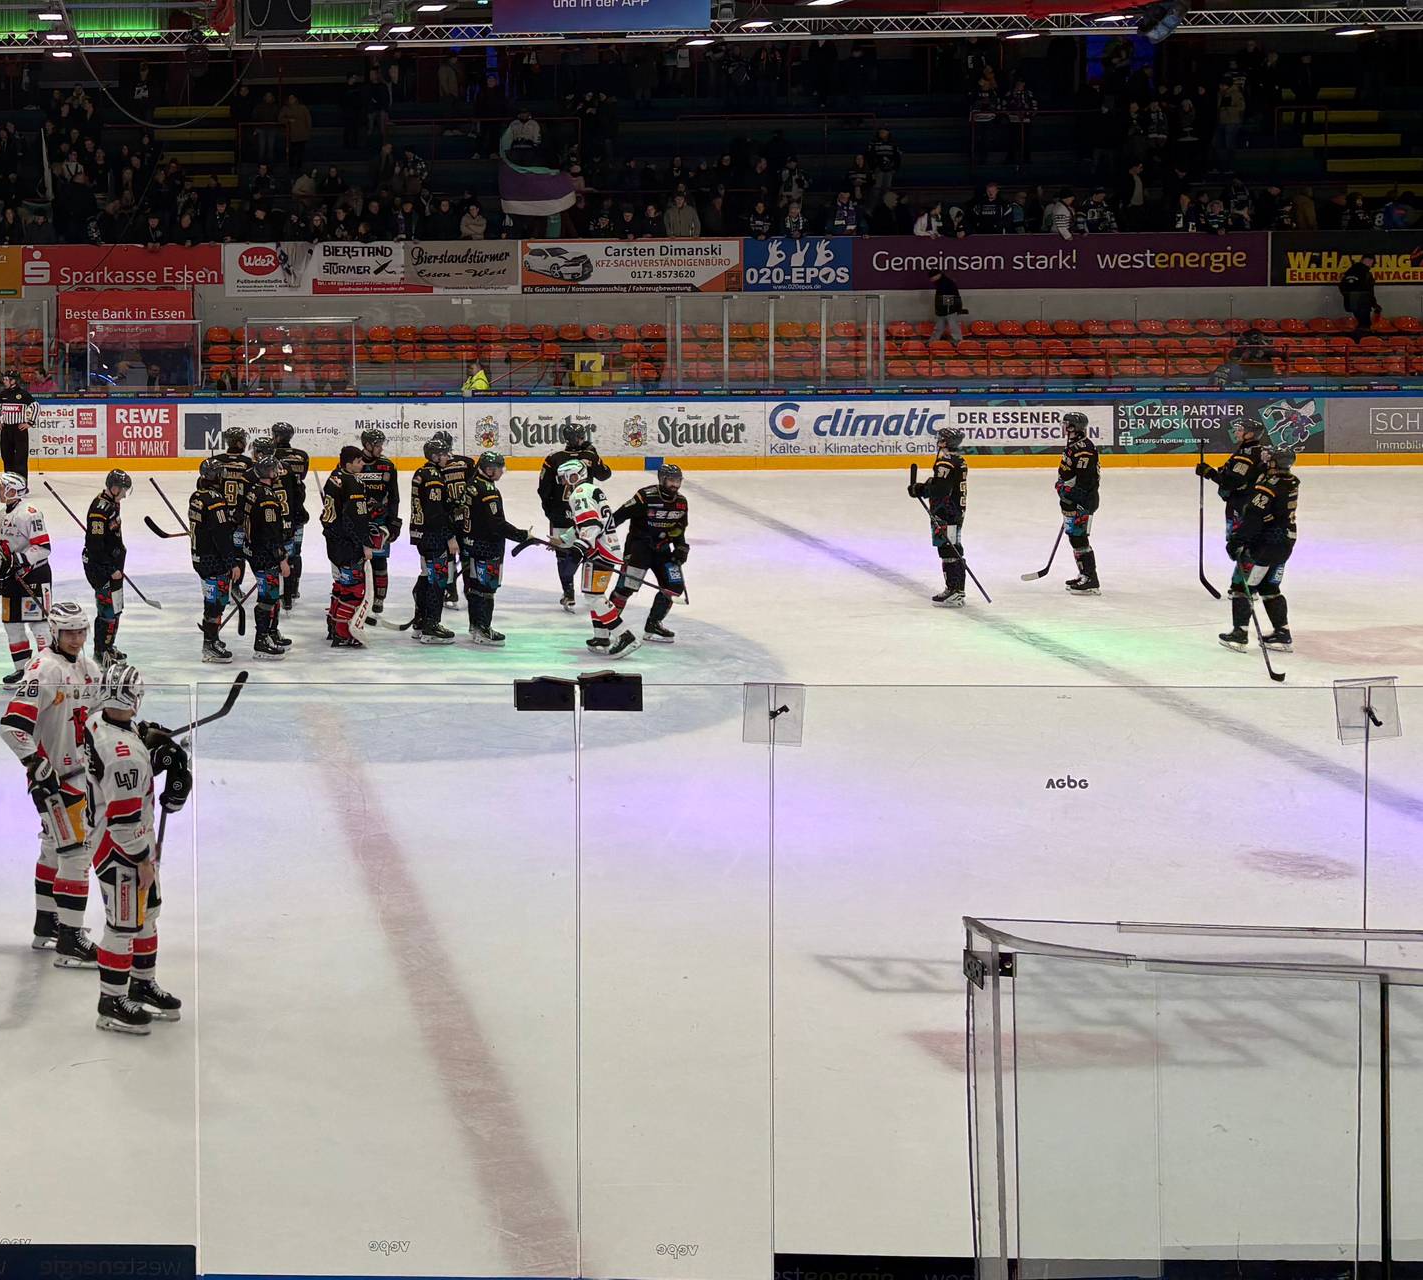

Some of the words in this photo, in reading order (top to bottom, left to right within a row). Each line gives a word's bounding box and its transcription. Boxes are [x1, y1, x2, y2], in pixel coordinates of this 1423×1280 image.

[323, 245, 393, 258] BIERSTAND
[411, 246, 511, 268] Bierstandstürmer
[604, 246, 656, 258] Carsten
[660, 245, 722, 257] Dimanski
[595, 257, 731, 268] KFZ-SACHVERSTÄNDIGENBÜRO
[872, 251, 1005, 271] Gemeinsam
[1012, 249, 1077, 270] stark!
[1096, 246, 1248, 274] westenergie
[59, 267, 157, 286] Sparkasse
[163, 266, 218, 284] Essen
[417, 270, 451, 278] Essen
[465, 267, 507, 278] West
[631, 269, 696, 280] 0171-8573620
[745, 267, 850, 284] 020-EPOS
[523, 286, 534, 294] Kfz
[534, 286, 567, 294] Gutachten
[632, 285, 692, 295] Fahrzeugbewertung
[65, 309, 99, 320] Beste
[102, 309, 131, 319] Bank
[134, 309, 146, 319] in
[150, 309, 185, 319] Essen
[40, 408, 75, 417] en-Süd
[116, 408, 170, 424] REWE
[1118, 404, 1179, 417] STOLZER
[1182, 404, 1244, 416] PARTNER
[69, 419, 76, 429] 3
[355, 418, 411, 430] Märkische
[413, 418, 458, 430] Revision
[812, 407, 946, 438] climatic
[957, 411, 988, 424] DER
[992, 411, 1060, 424] ESSENER
[1118, 418, 1145, 430] DER
[1149, 417, 1221, 430] MOSKITOS
[122, 425, 163, 439] GROB
[248, 427, 261, 435] Wir
[294, 426, 315, 436] Ihren
[316, 426, 341, 438] Erfolg.
[657, 414, 745, 448] Stauder
[43, 446, 59, 456] Tor
[63, 446, 75, 456] 14
[116, 441, 141, 457] DEIN
[142, 441, 170, 457] MARKT
[770, 442, 805, 455] Kälte-
[809, 444, 820, 454] u.
[824, 442, 902, 454] Klimatechnik
[906, 442, 938, 454] Gmb
[15, 678, 40, 698] 28
[114, 769, 139, 791] 47
